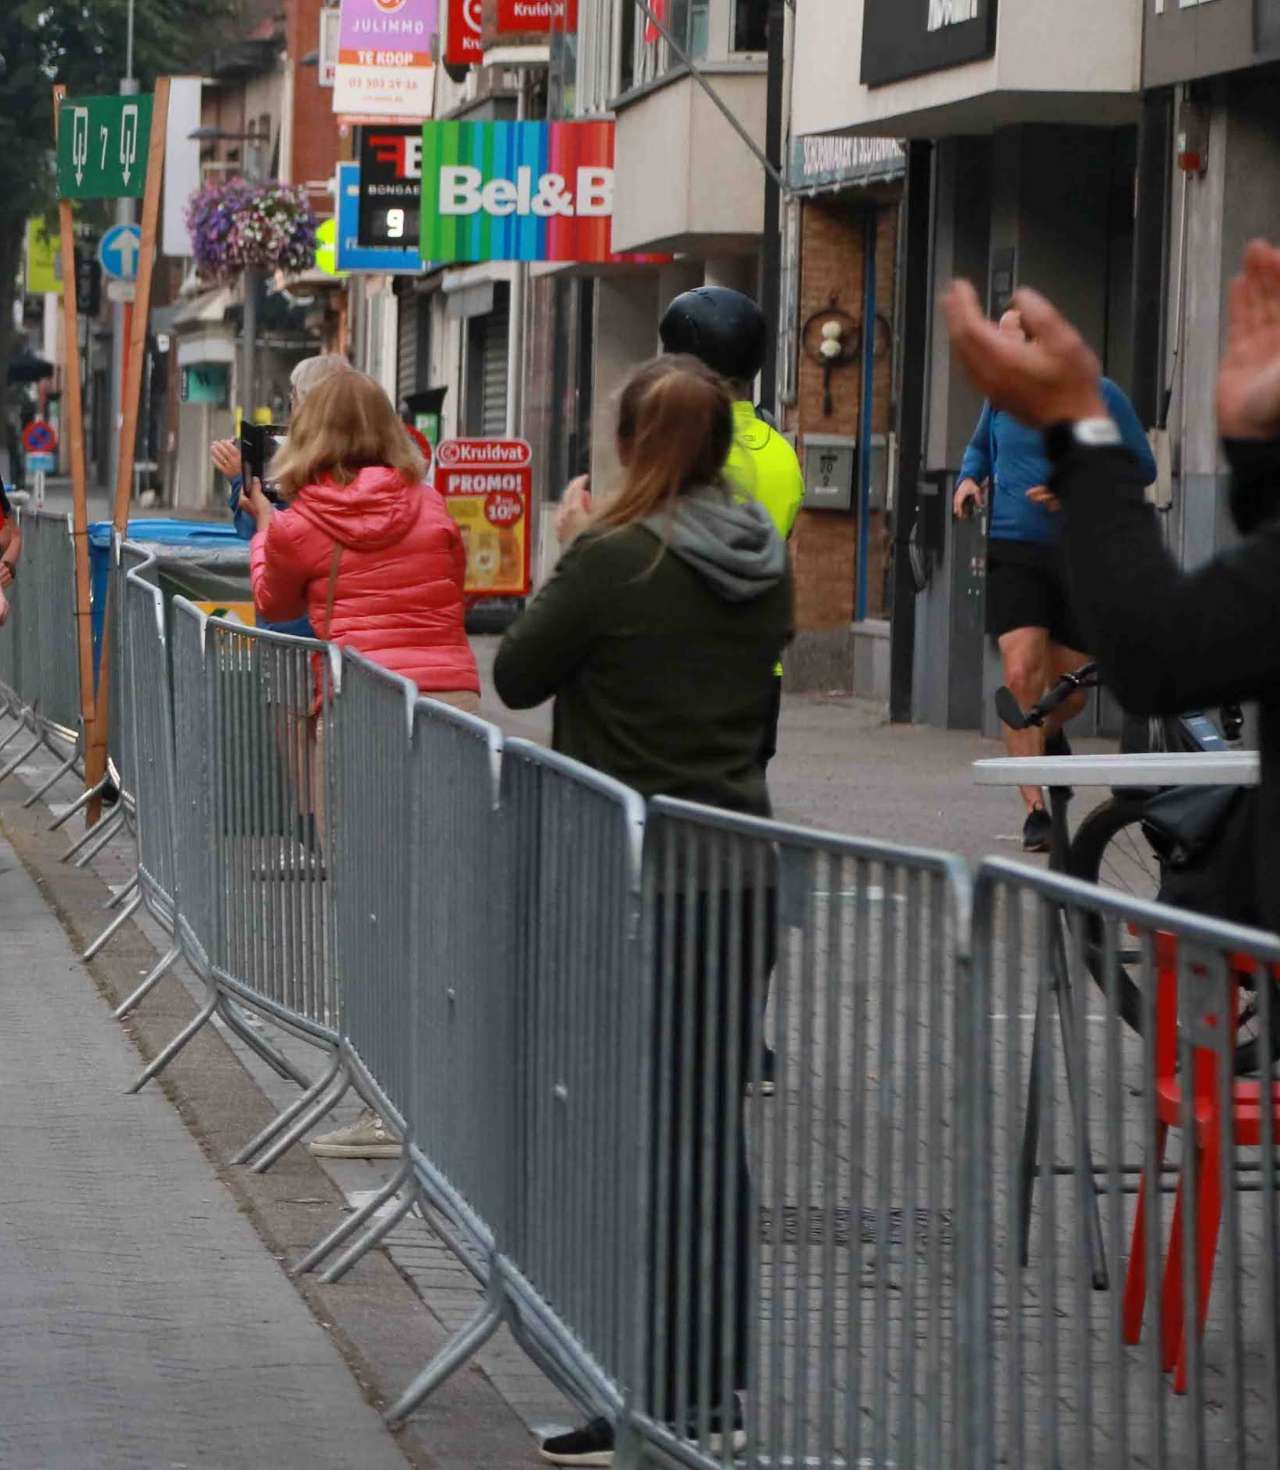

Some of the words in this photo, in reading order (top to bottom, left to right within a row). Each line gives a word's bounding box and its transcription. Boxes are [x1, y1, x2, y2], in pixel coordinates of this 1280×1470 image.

[352, 19, 424, 34] JULIMMO
[357, 51, 374, 65] TE
[376, 51, 414, 66] KOOP
[99, 124, 109, 171] 7
[386, 208, 405, 238] 9
[460, 444, 523, 461] Kruidvat
[448, 474, 522, 493] PROMO!
